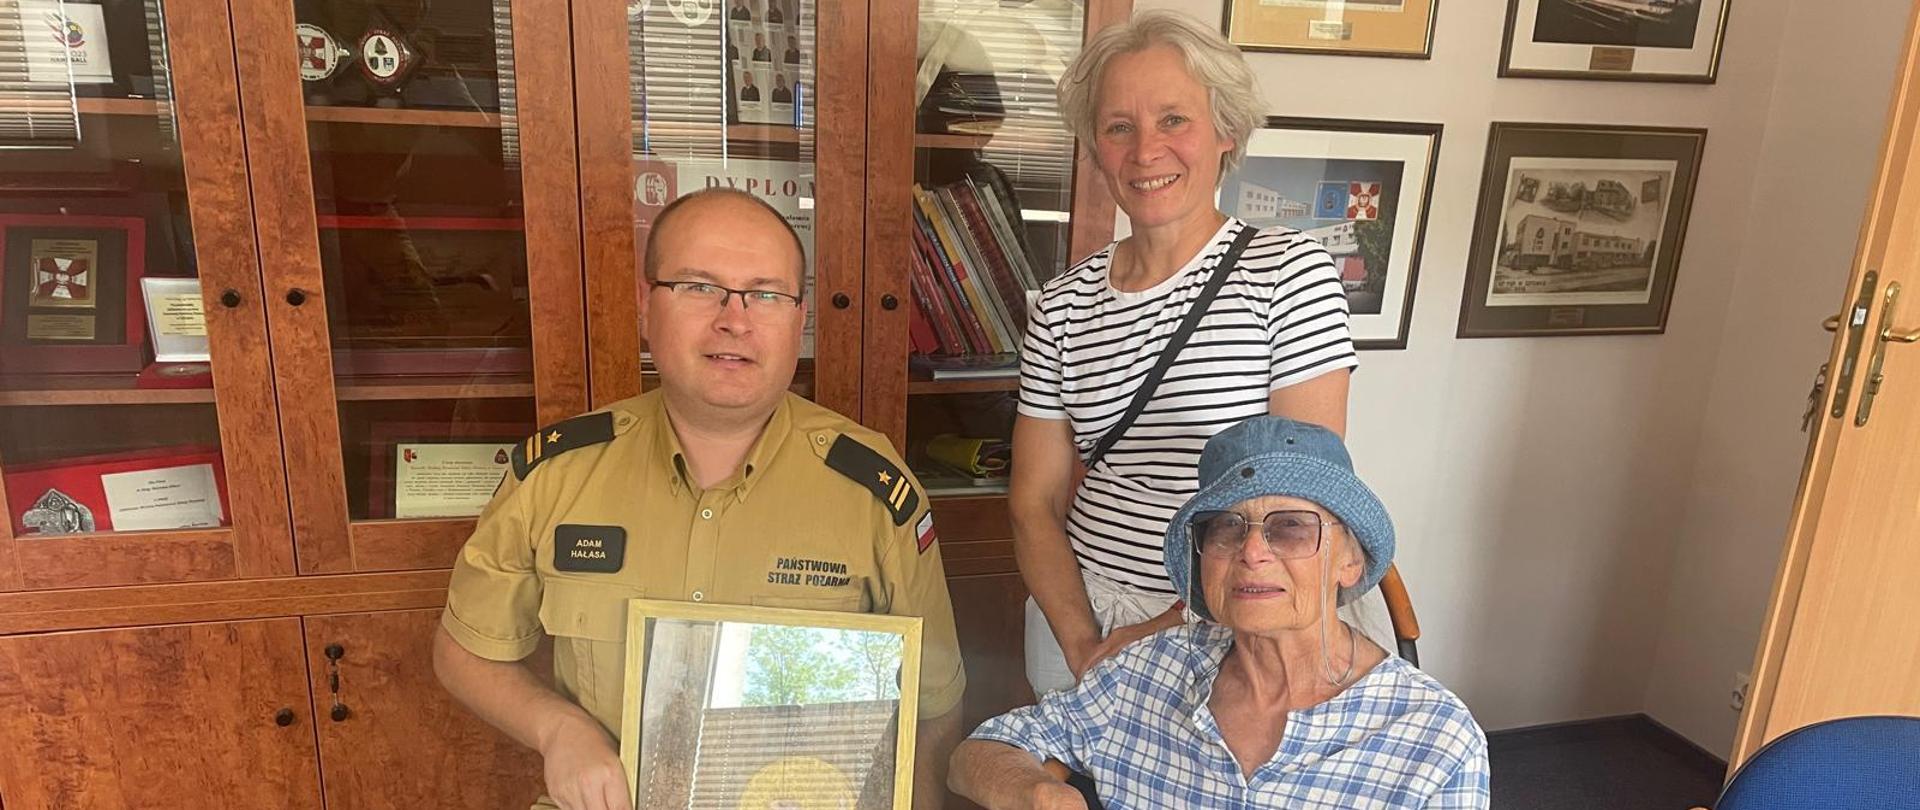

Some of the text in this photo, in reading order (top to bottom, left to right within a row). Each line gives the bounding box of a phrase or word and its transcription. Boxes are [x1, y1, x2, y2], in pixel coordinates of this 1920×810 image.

[575, 538, 603, 548] ADAM
[570, 549, 607, 559] HAŁASA
[776, 557, 847, 575] PAŃSTWOWA
